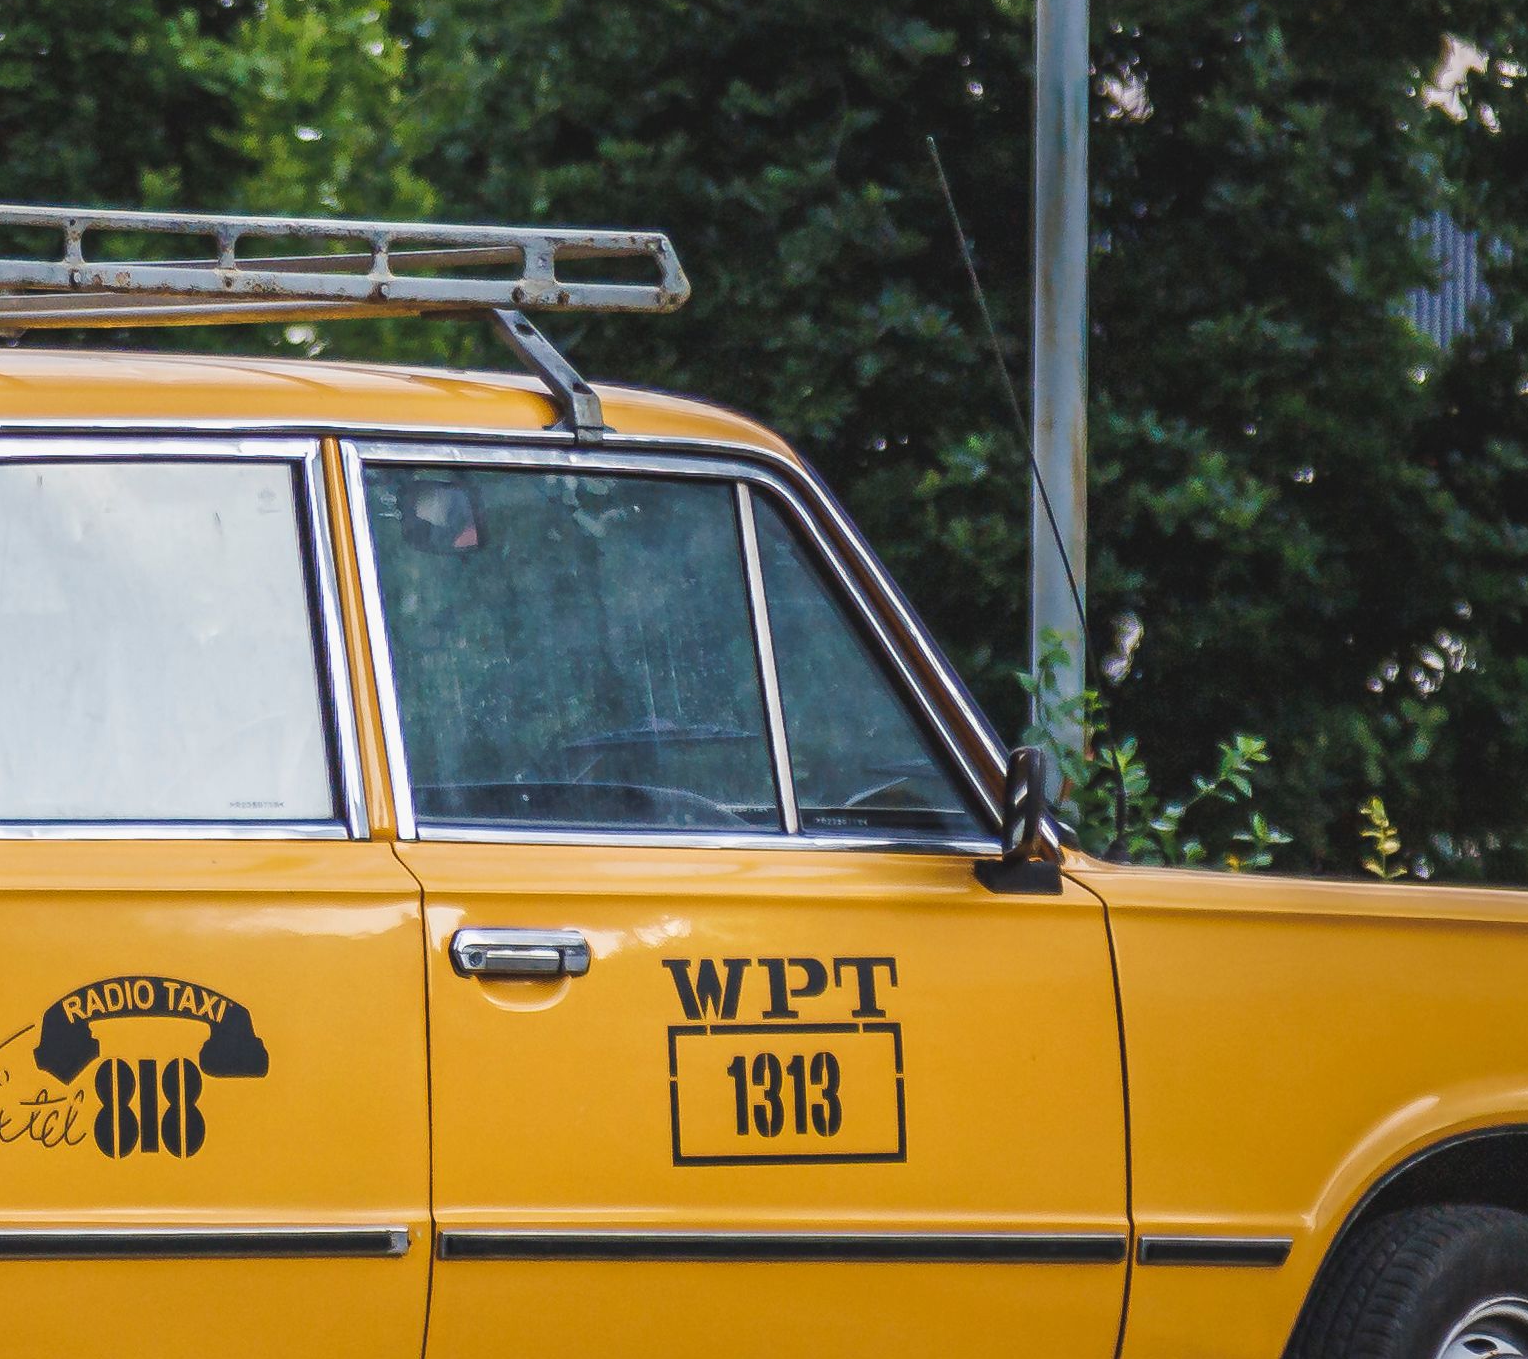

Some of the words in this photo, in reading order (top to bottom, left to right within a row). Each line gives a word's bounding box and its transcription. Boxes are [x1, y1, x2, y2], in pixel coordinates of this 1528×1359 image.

[62, 979, 155, 1024] RADIO
[163, 981, 228, 1024] TAXI
[661, 956, 899, 1021] WPT
[94, 1057, 206, 1159] 818
[727, 1051, 842, 1138] 1313
